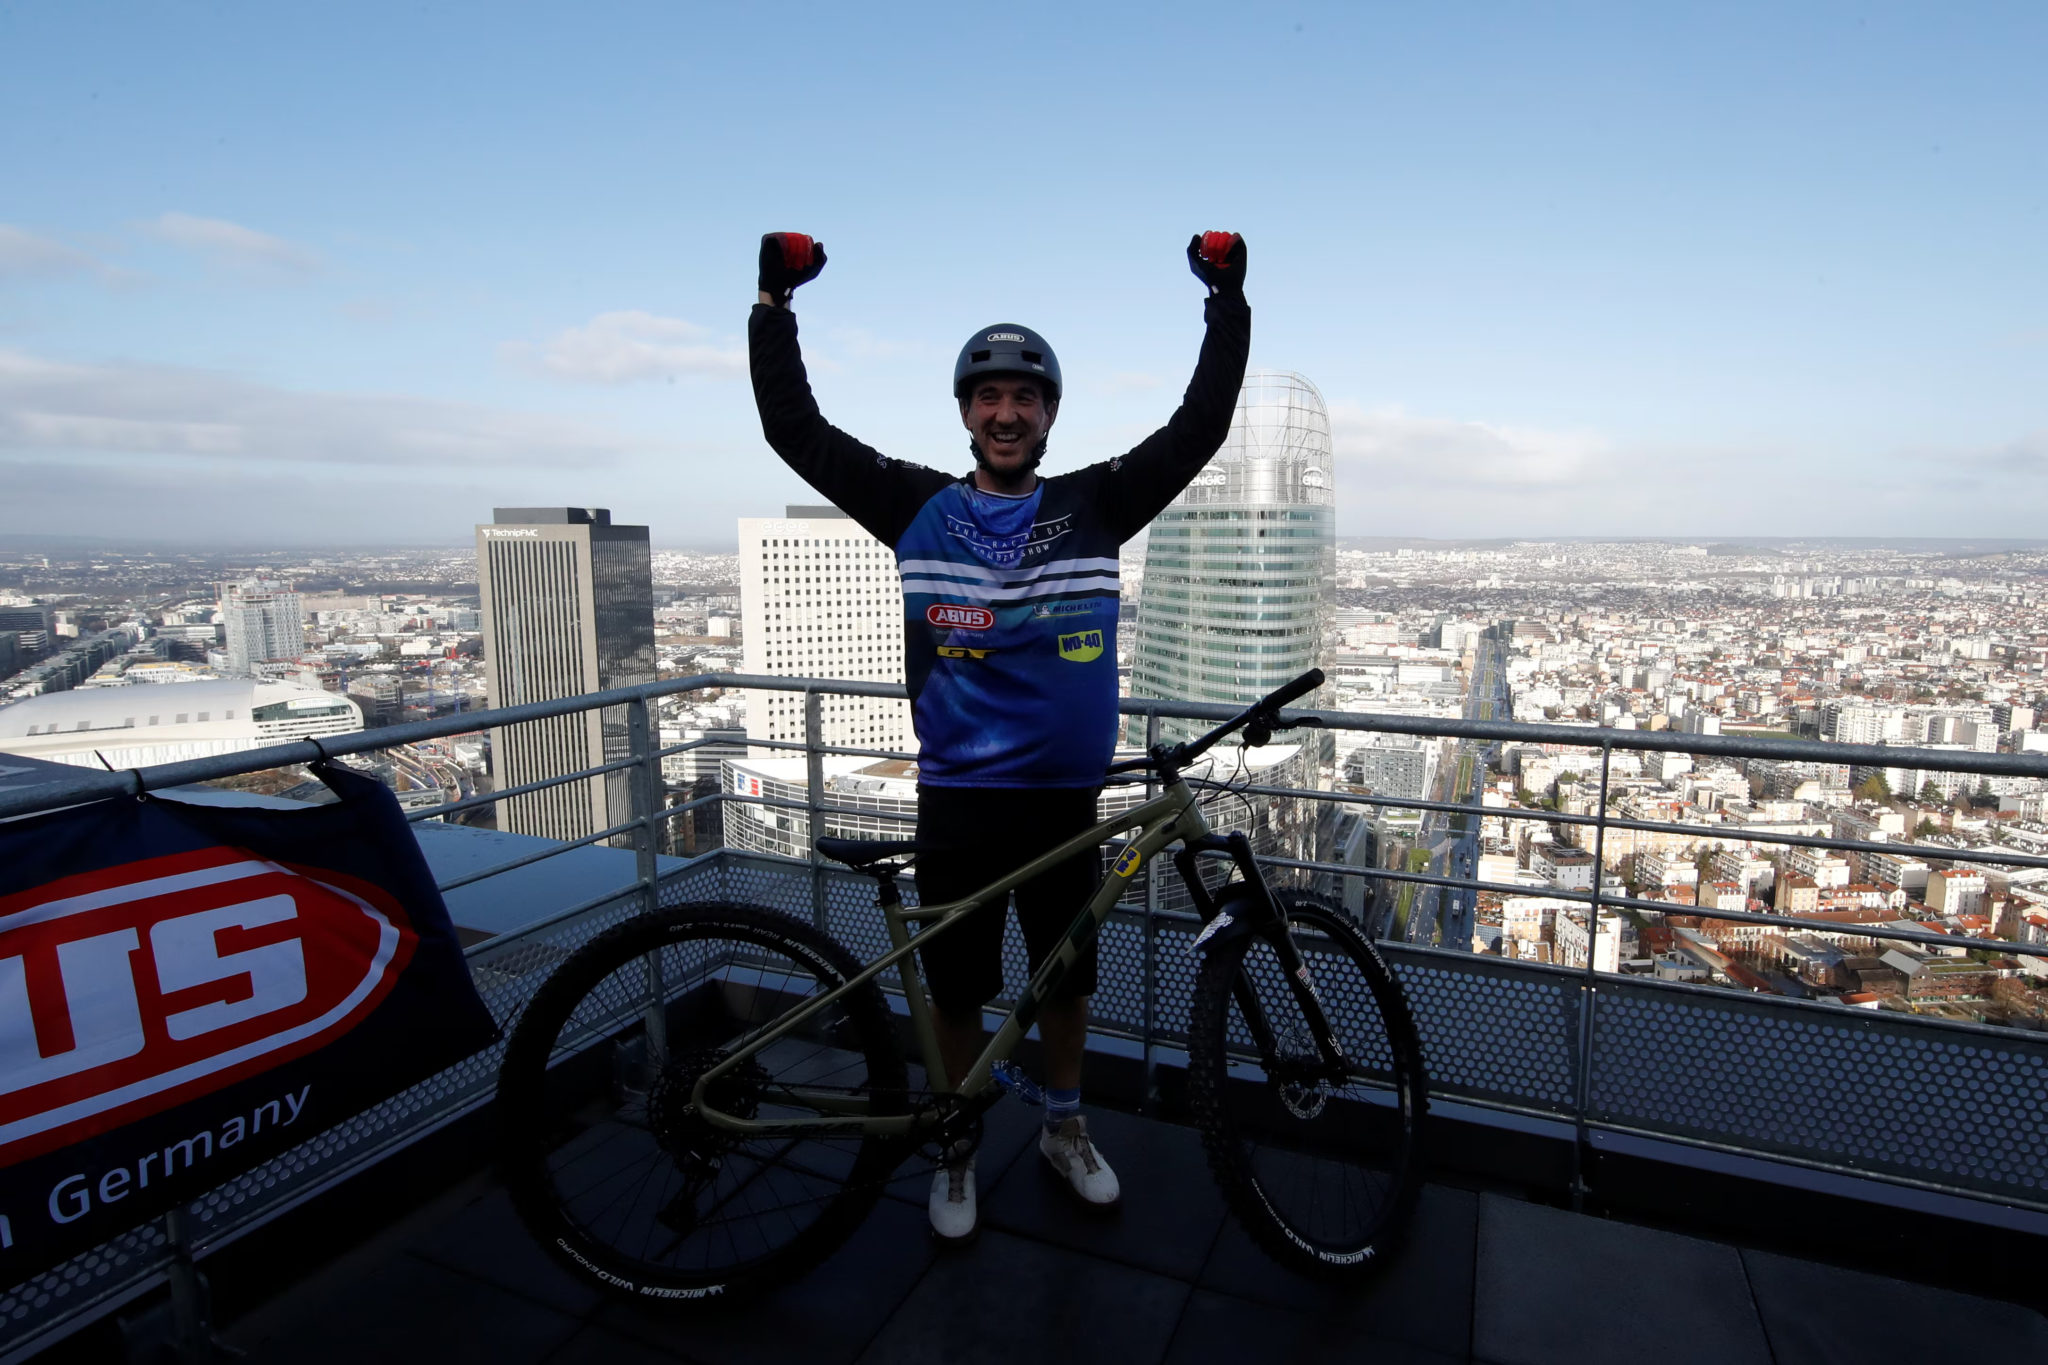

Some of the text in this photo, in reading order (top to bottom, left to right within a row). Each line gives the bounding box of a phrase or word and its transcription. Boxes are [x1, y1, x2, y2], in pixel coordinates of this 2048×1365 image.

[992, 333, 1020, 341] ABUS
[492, 529, 538, 538] TechnipFMC
[936, 608, 985, 625] ABUS
[48, 1082, 313, 1226] Germany
[1319, 1251, 1364, 1264] MICHELIN
[640, 1286, 708, 1299] MICHELIN
